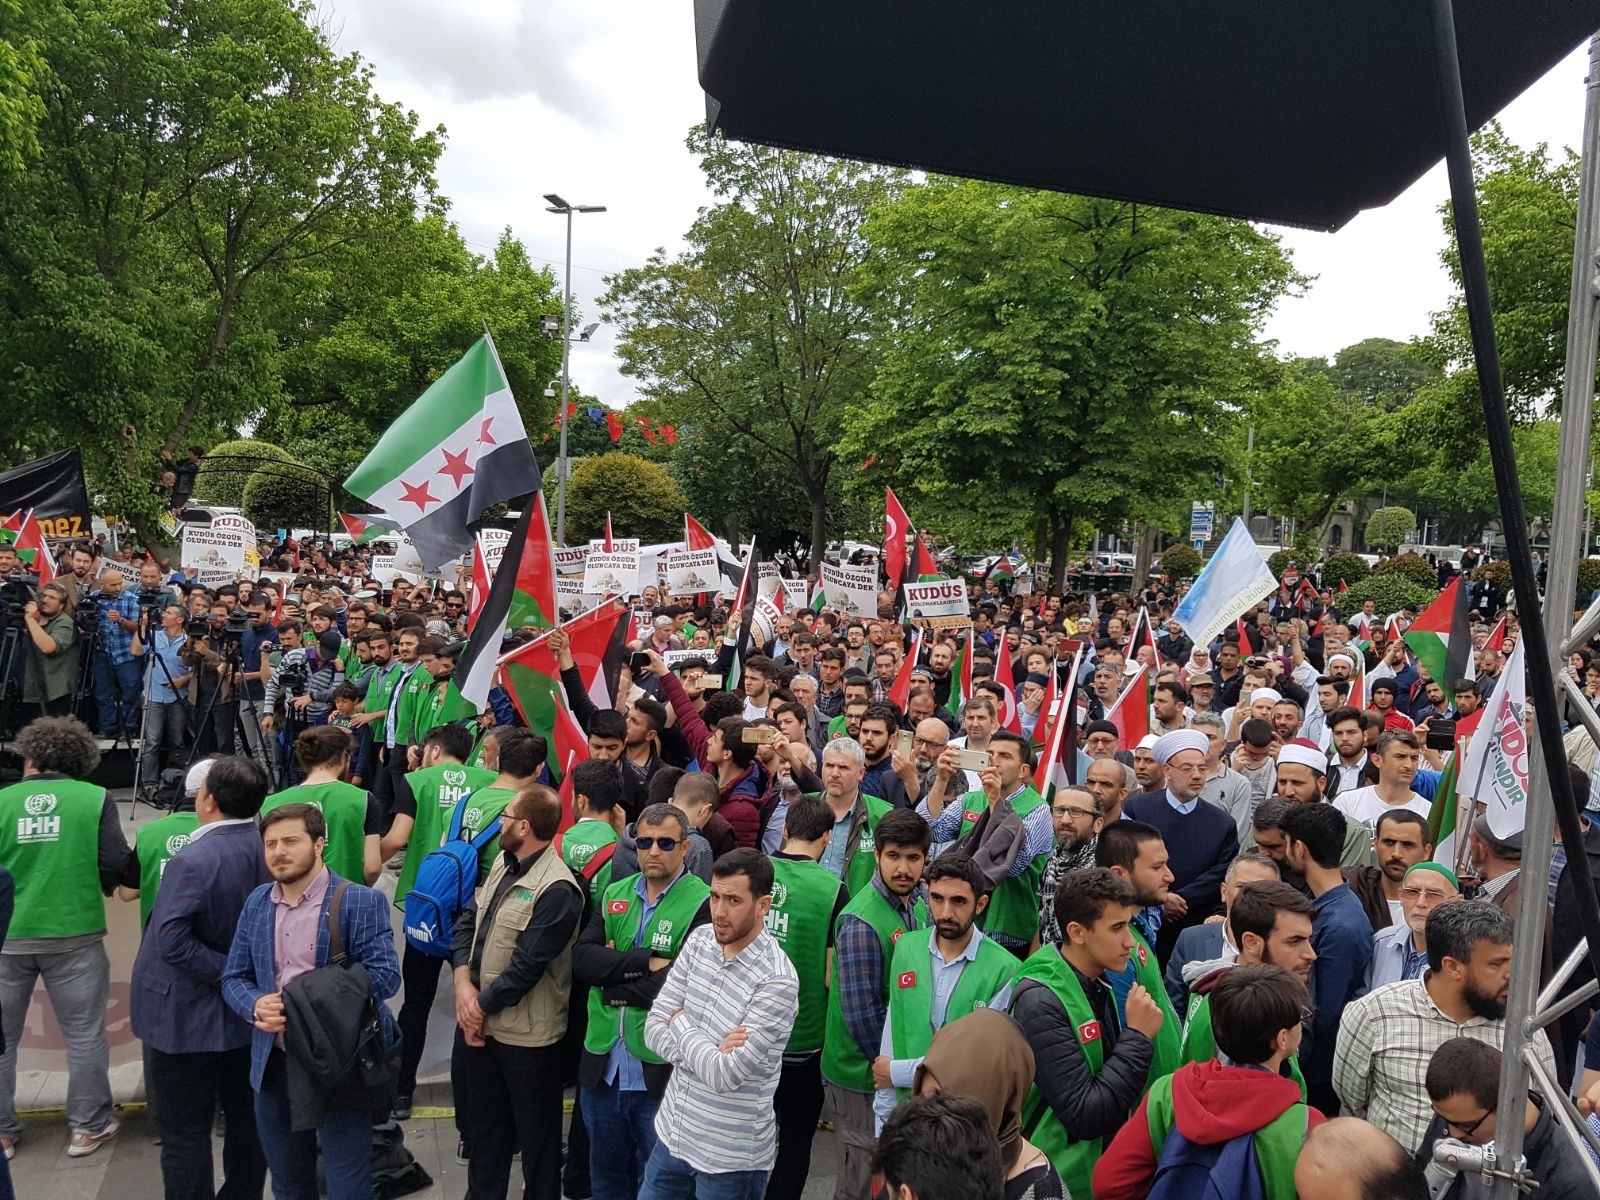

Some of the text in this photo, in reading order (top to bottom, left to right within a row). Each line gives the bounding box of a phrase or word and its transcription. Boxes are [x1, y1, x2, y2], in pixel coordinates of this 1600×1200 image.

[188, 530, 214, 538] KUDÜS
[216, 532, 242, 541] ÖZGÜR
[186, 537, 227, 546] OLUNCAYA
[611, 555, 636, 563] ÖZGÜR
[670, 552, 713, 562] KUDÜS ÖZGÜR
[669, 561, 701, 569] OLUNCAYA
[823, 566, 873, 584] KUDÜS ÖZGÜR
[823, 573, 874, 592] OLUNCAYA DEK
[908, 582, 963, 600] KUDÜS
[763, 910, 789, 932] HH
